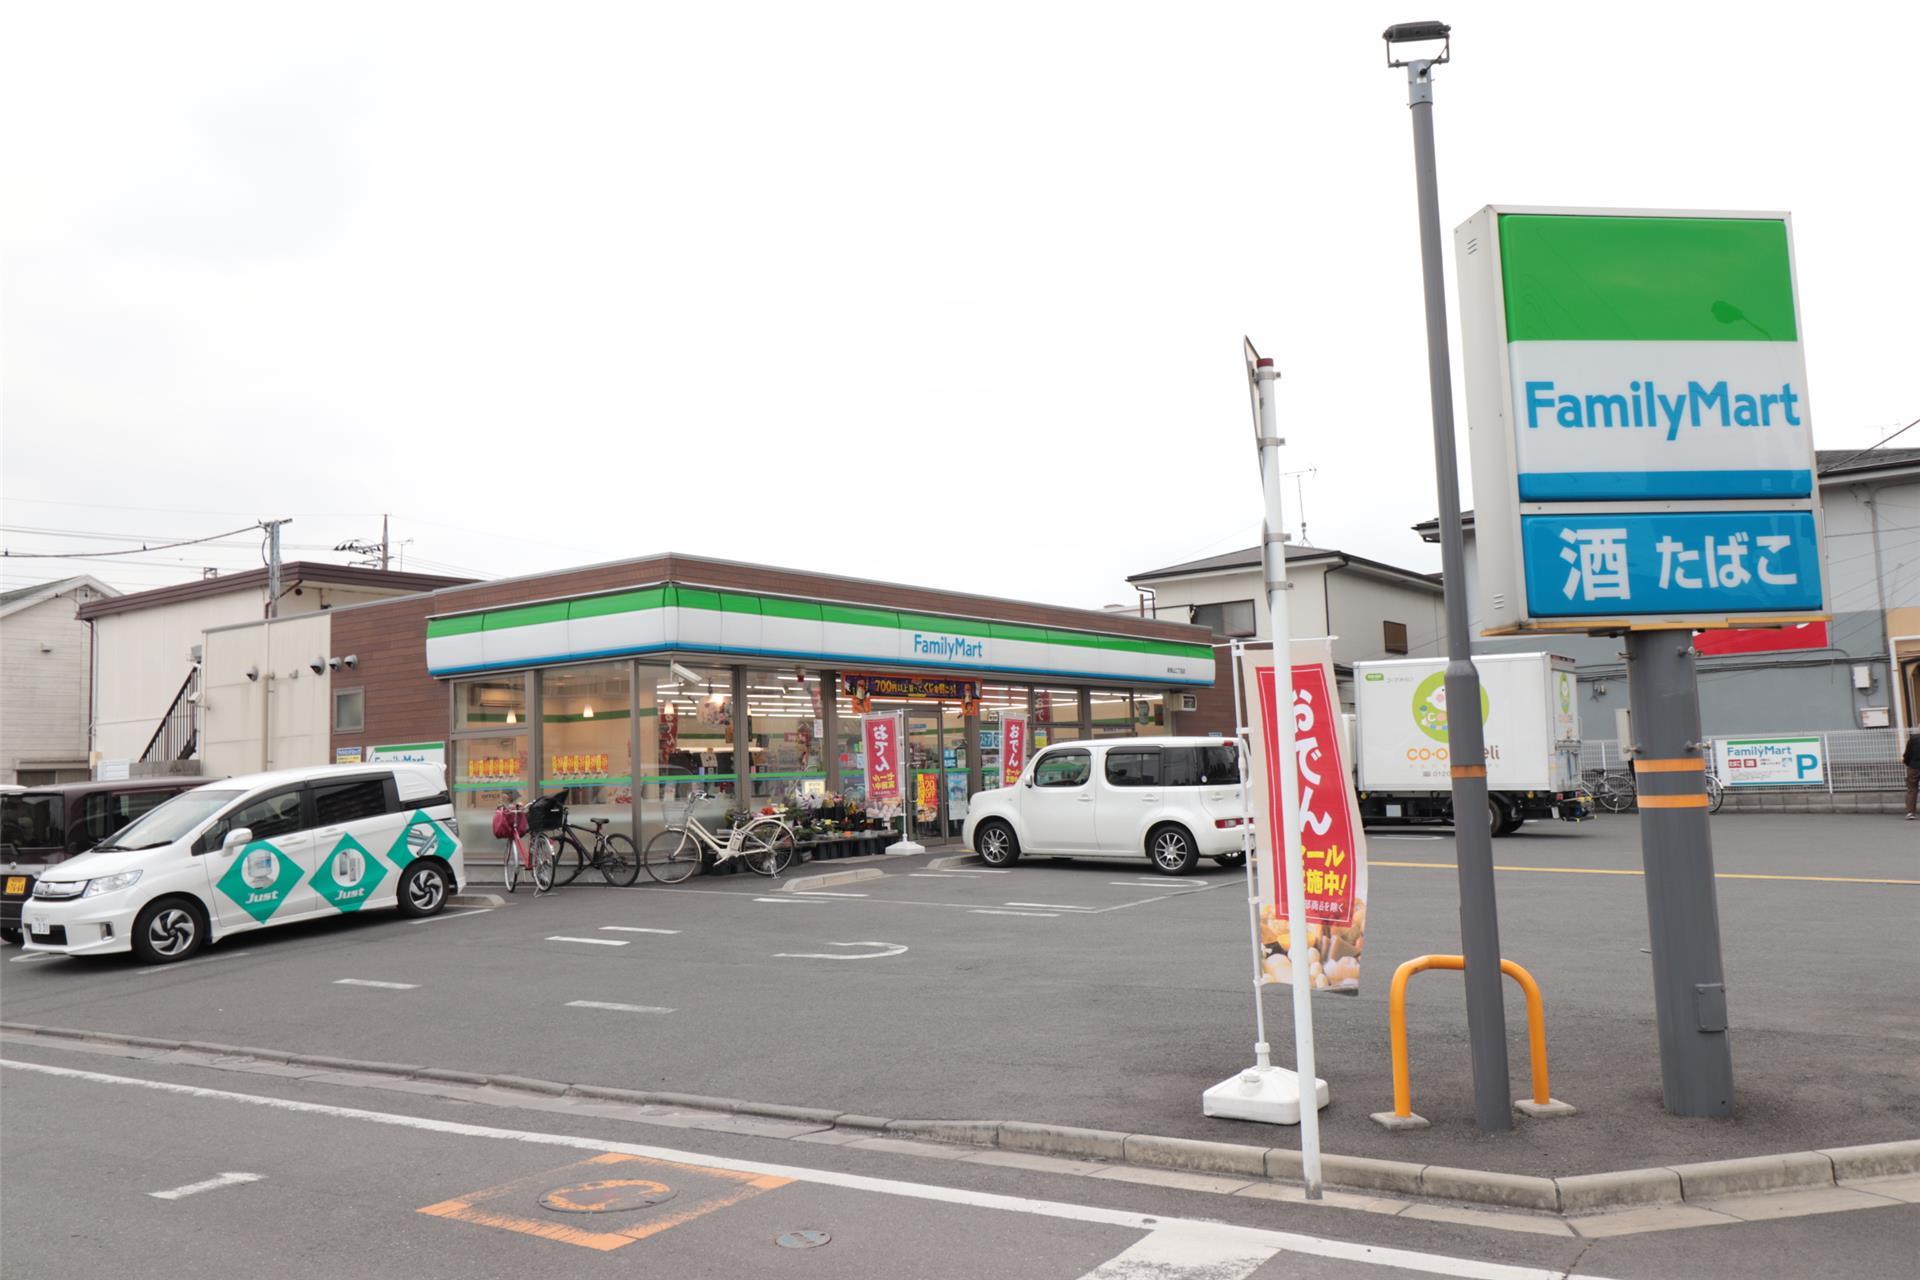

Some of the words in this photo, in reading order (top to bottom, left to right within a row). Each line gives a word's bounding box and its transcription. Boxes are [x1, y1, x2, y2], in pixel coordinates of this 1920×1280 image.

[1524, 381, 1801, 441] FamilyMart
[1559, 528, 1631, 601] 酒
[1656, 532, 1797, 590] たばこ
[914, 634, 982, 659] FamilyMart
[1009, 725, 1020, 768] おでん
[1483, 745, 1500, 760] eli
[1727, 745, 1793, 758] FamilyMart
[1796, 754, 1818, 779] P
[1301, 845, 1345, 868] ール
[334, 887, 365, 901] Just
[1302, 868, 1347, 897] 施中!
[245, 890, 279, 904] Just
